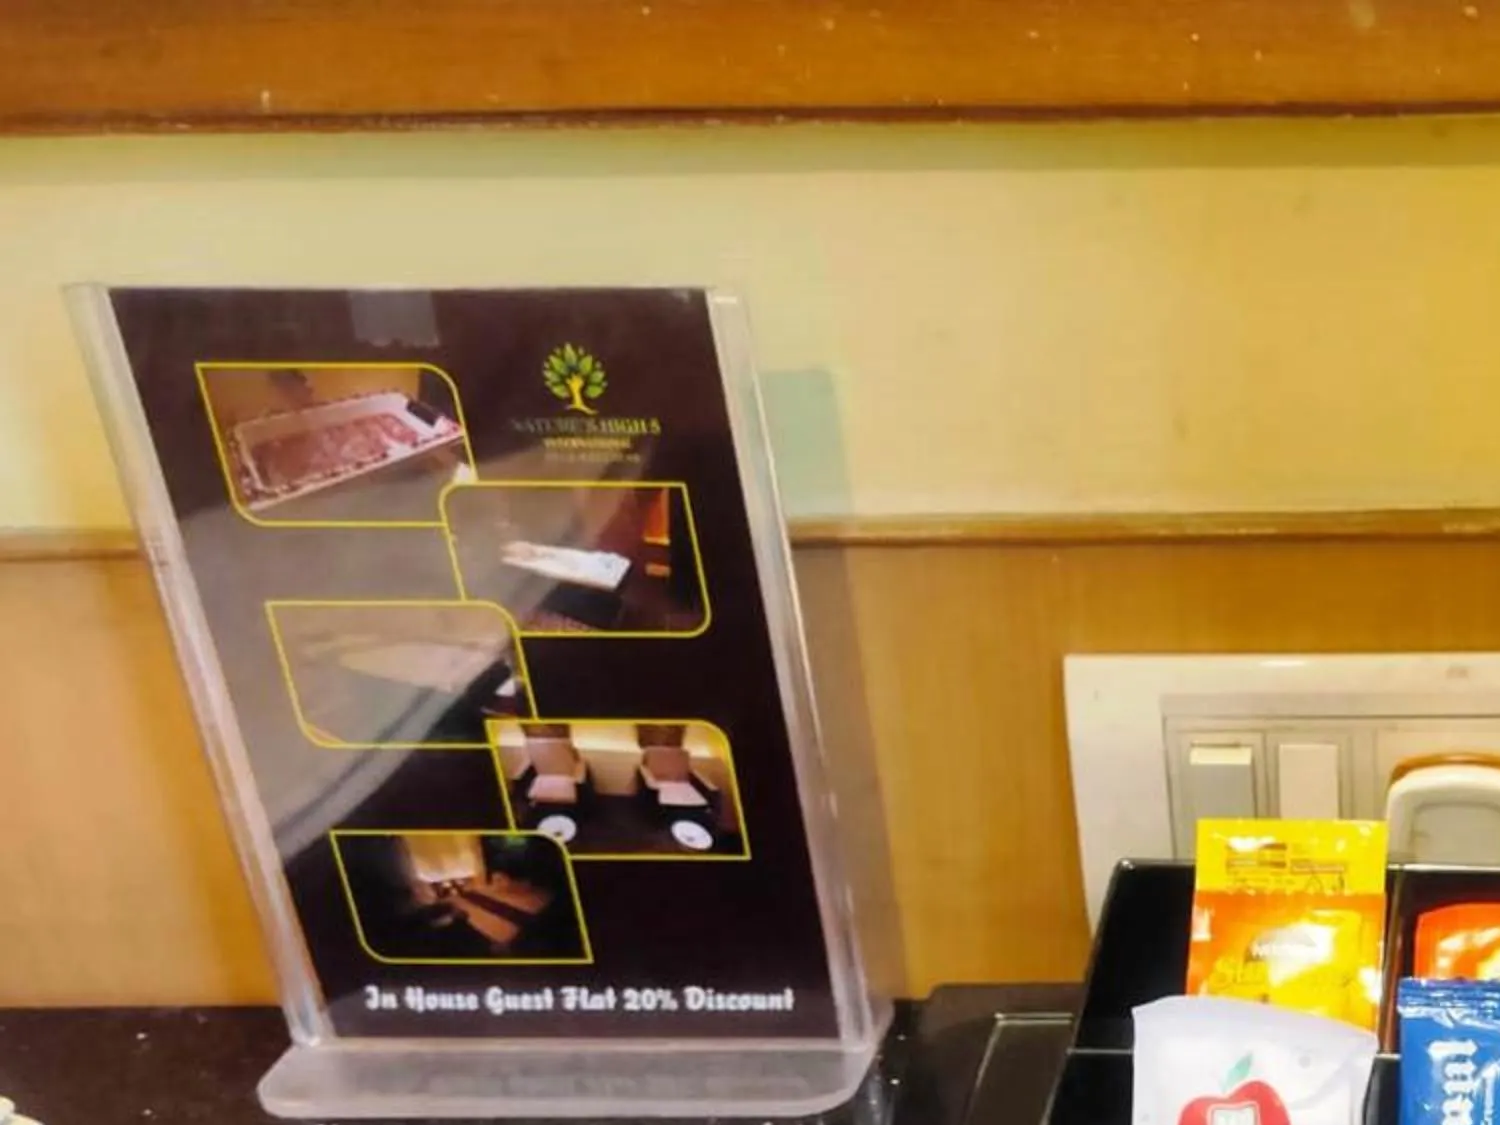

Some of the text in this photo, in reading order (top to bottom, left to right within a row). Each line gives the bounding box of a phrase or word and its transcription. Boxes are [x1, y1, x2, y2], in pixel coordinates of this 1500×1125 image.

[364, 985, 794, 1015] In House Guest Flat 20% Discount
